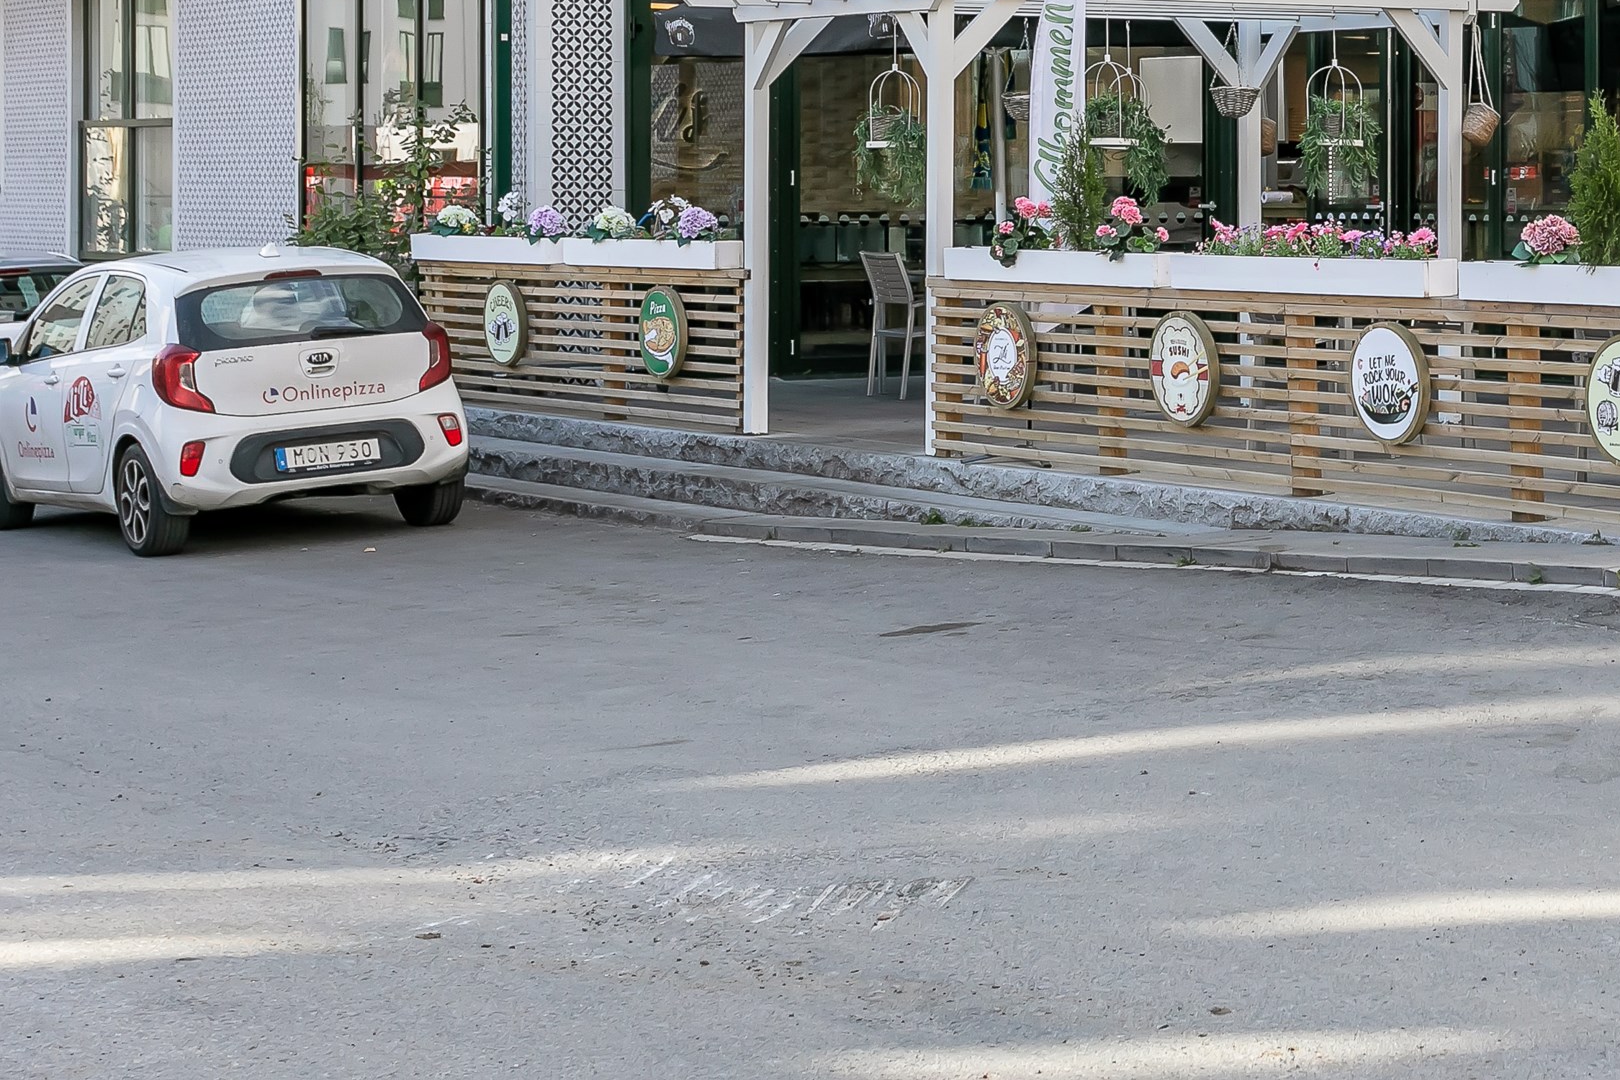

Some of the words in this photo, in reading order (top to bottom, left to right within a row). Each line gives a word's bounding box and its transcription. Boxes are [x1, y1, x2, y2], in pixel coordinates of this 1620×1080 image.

[1034, 4, 1075, 198] Vlkommen
[649, 300, 666, 315] Pizza
[311, 351, 331, 364] KIA
[1168, 345, 1190, 358] SUSHI
[1369, 356, 1383, 370] LET
[1384, 354, 1396, 367] ME
[1363, 369, 1384, 386] ROCK
[1385, 367, 1406, 386] YOUR
[282, 381, 386, 401] Onlinepizza
[1371, 383, 1399, 405] WOK
[293, 445, 330, 466] MON
[336, 441, 372, 461] 930
